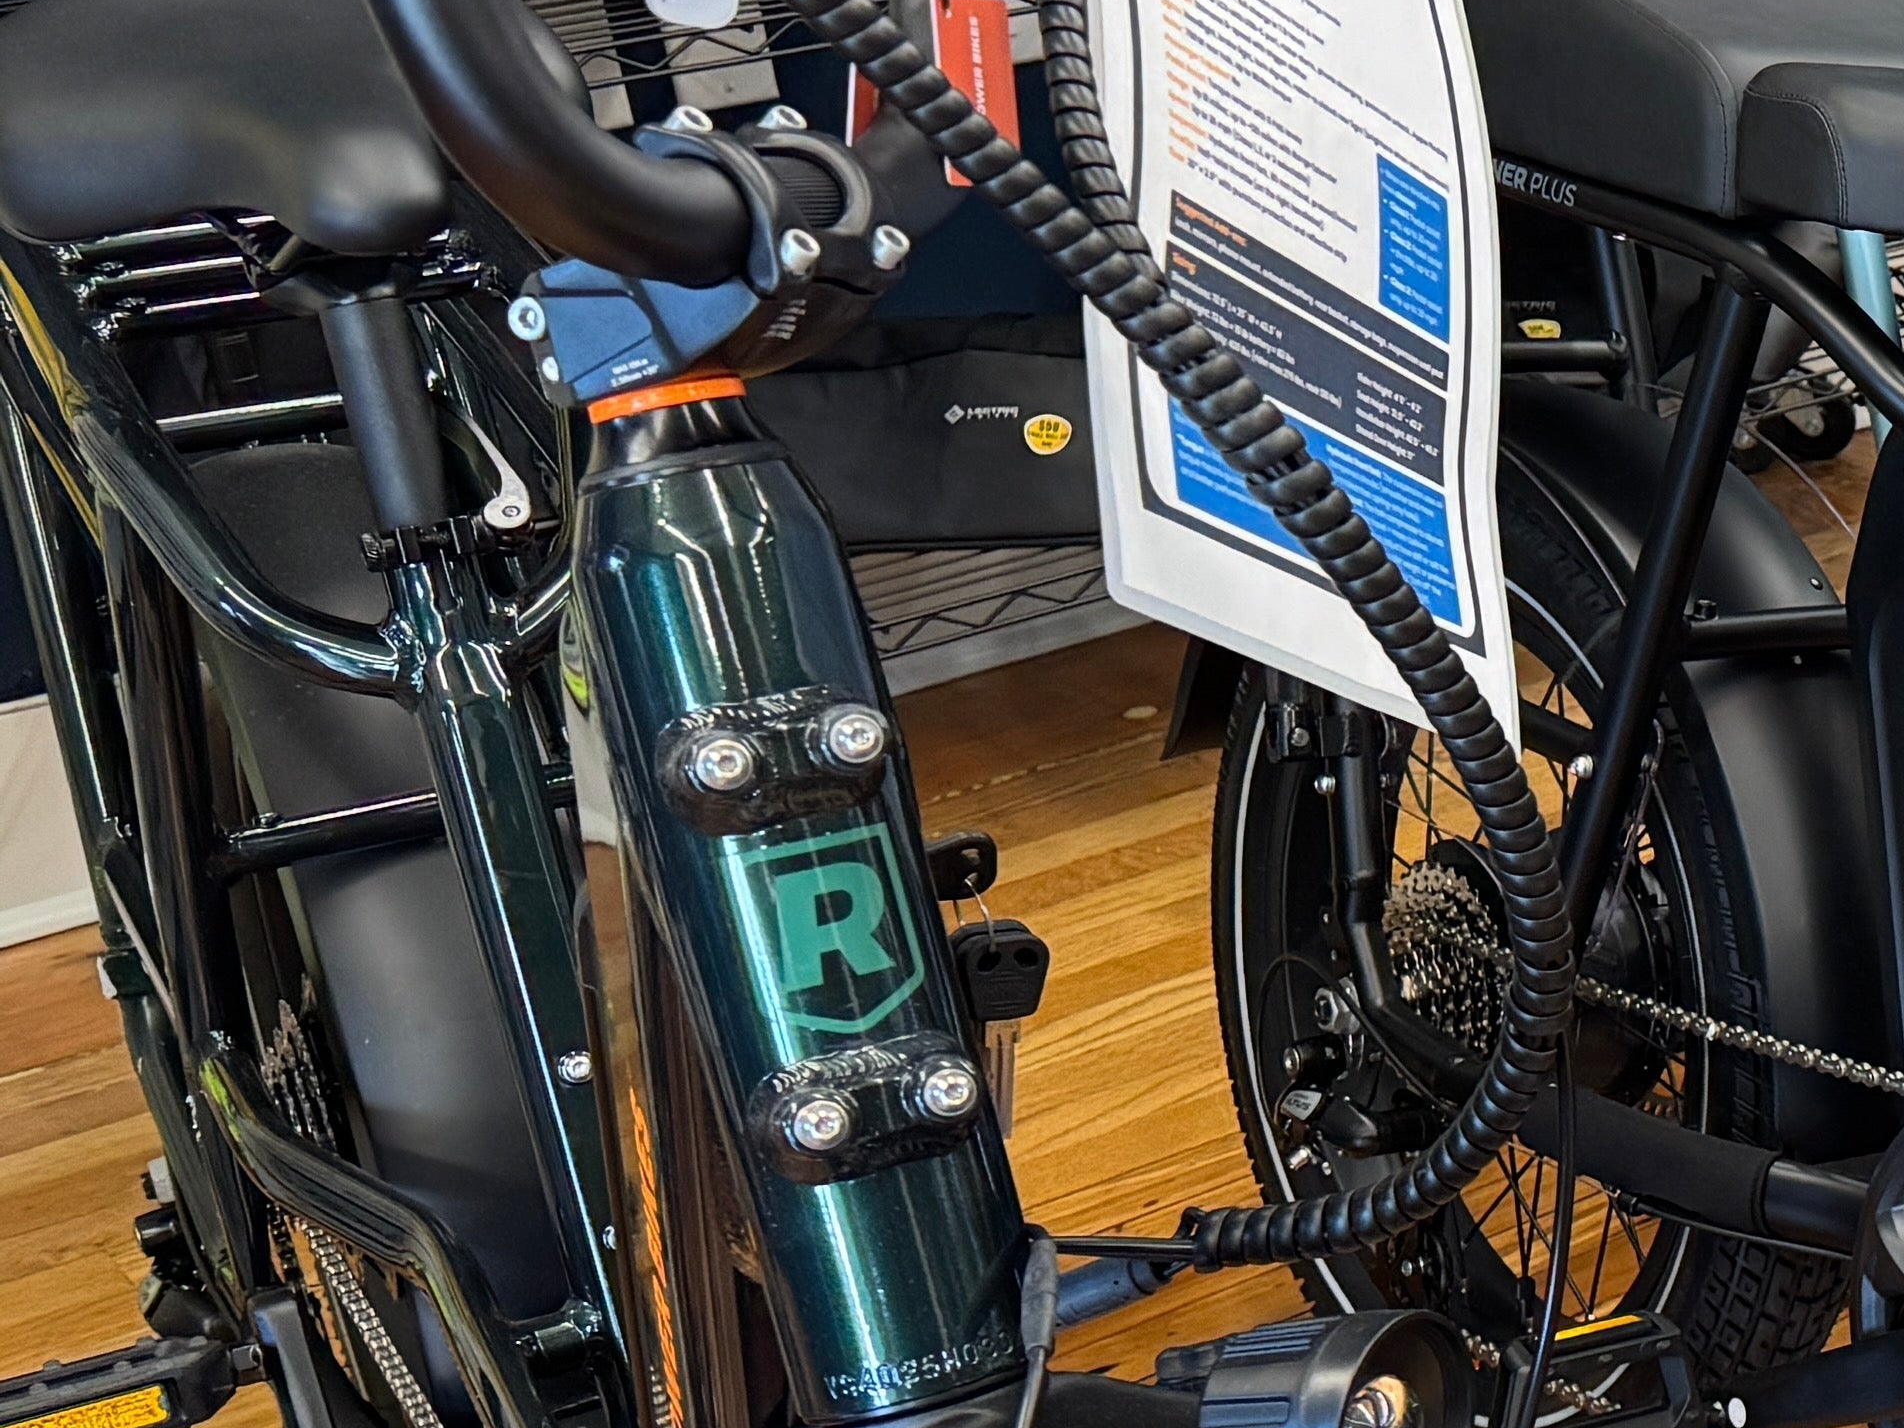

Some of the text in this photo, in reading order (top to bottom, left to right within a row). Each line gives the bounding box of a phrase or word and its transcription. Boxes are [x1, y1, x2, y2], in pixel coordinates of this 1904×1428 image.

[969, 16, 986, 116] BIKES OWER
[1531, 173, 1578, 207] PLUS
[775, 857, 898, 993] R
